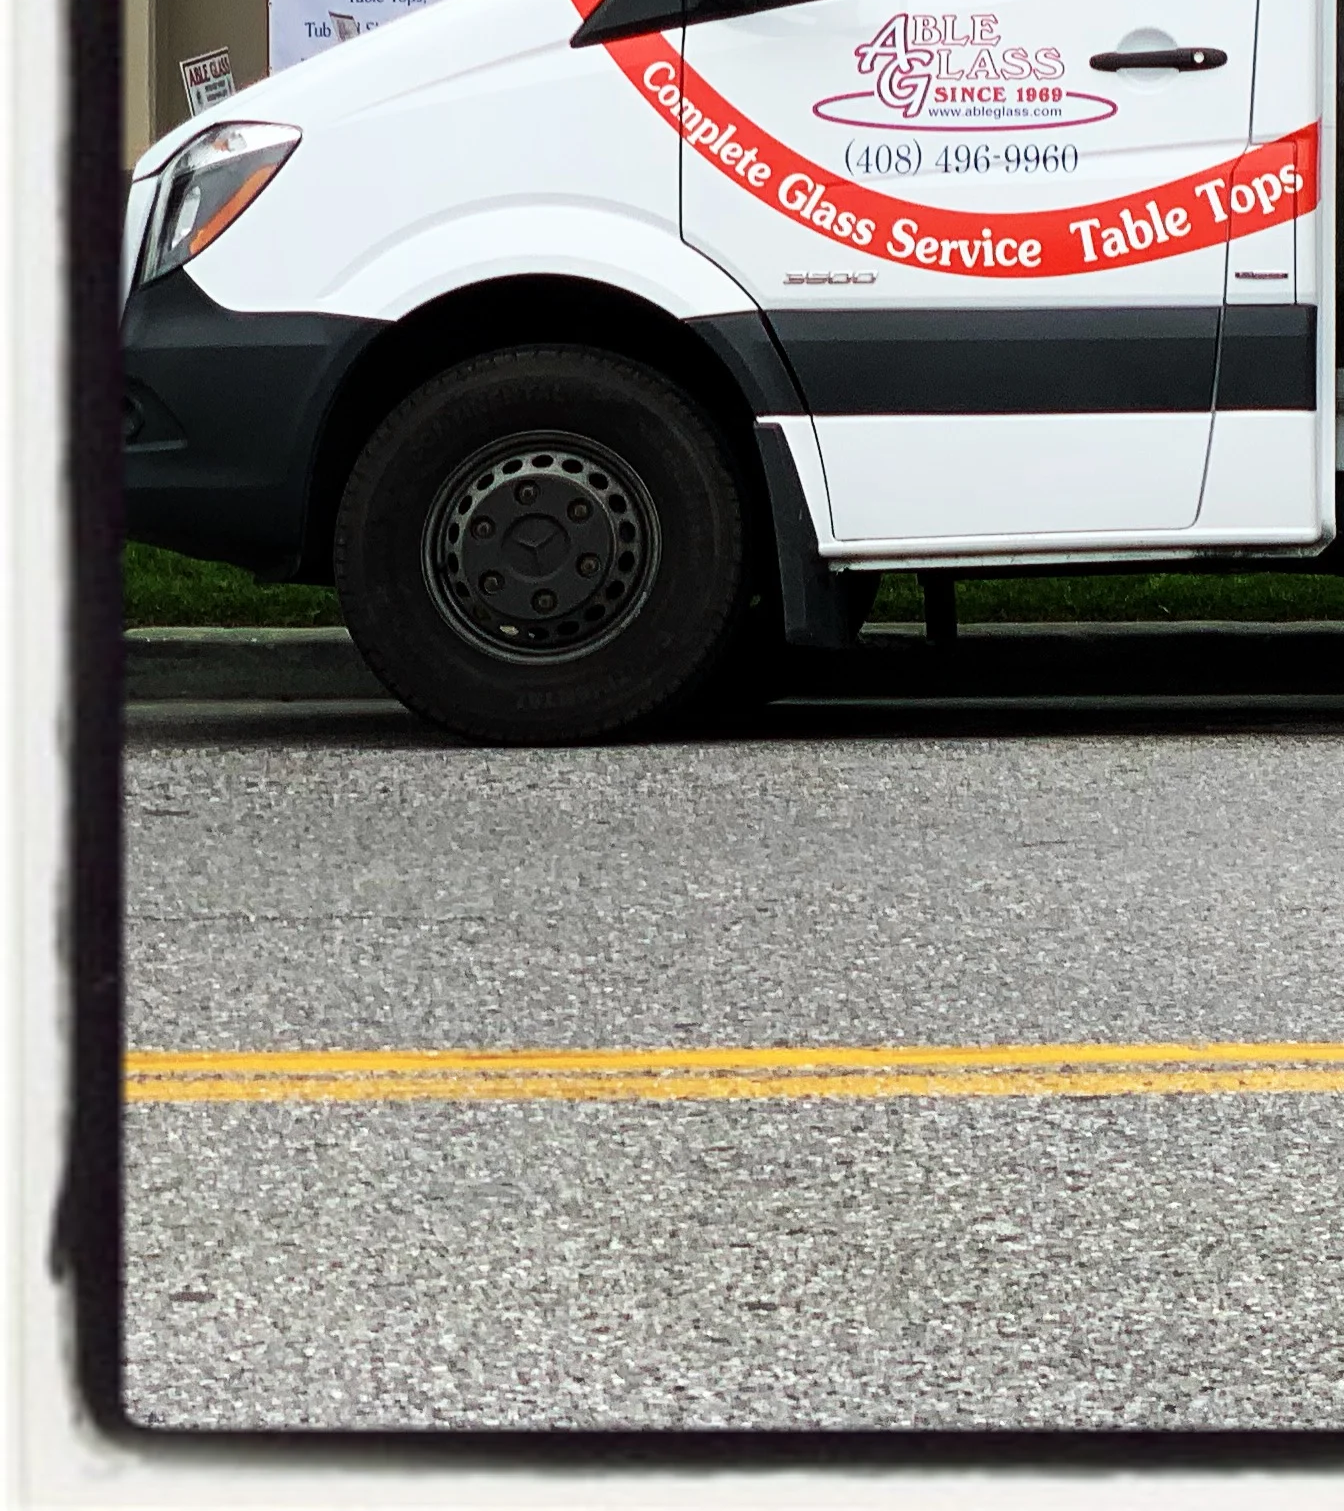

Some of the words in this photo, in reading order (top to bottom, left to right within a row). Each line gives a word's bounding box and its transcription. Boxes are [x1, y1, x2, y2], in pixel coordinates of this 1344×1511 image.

[305, 22, 331, 37] Tub
[855, 12, 1001, 73] ABLE
[876, 47, 1066, 118] GLASS
[933, 86, 1007, 103] SINCE
[1016, 86, 1063, 103] 1969
[928, 105, 1063, 119] www.ableglass.com
[643, 59, 772, 188] Complete
[778, 172, 876, 246] Glass
[886, 217, 1042, 269] Service
[1069, 201, 1192, 262] Table
[1195, 163, 1305, 224] Tops
[844, 139, 922, 177] (408)
[935, 144, 1079, 175] 496-9960
